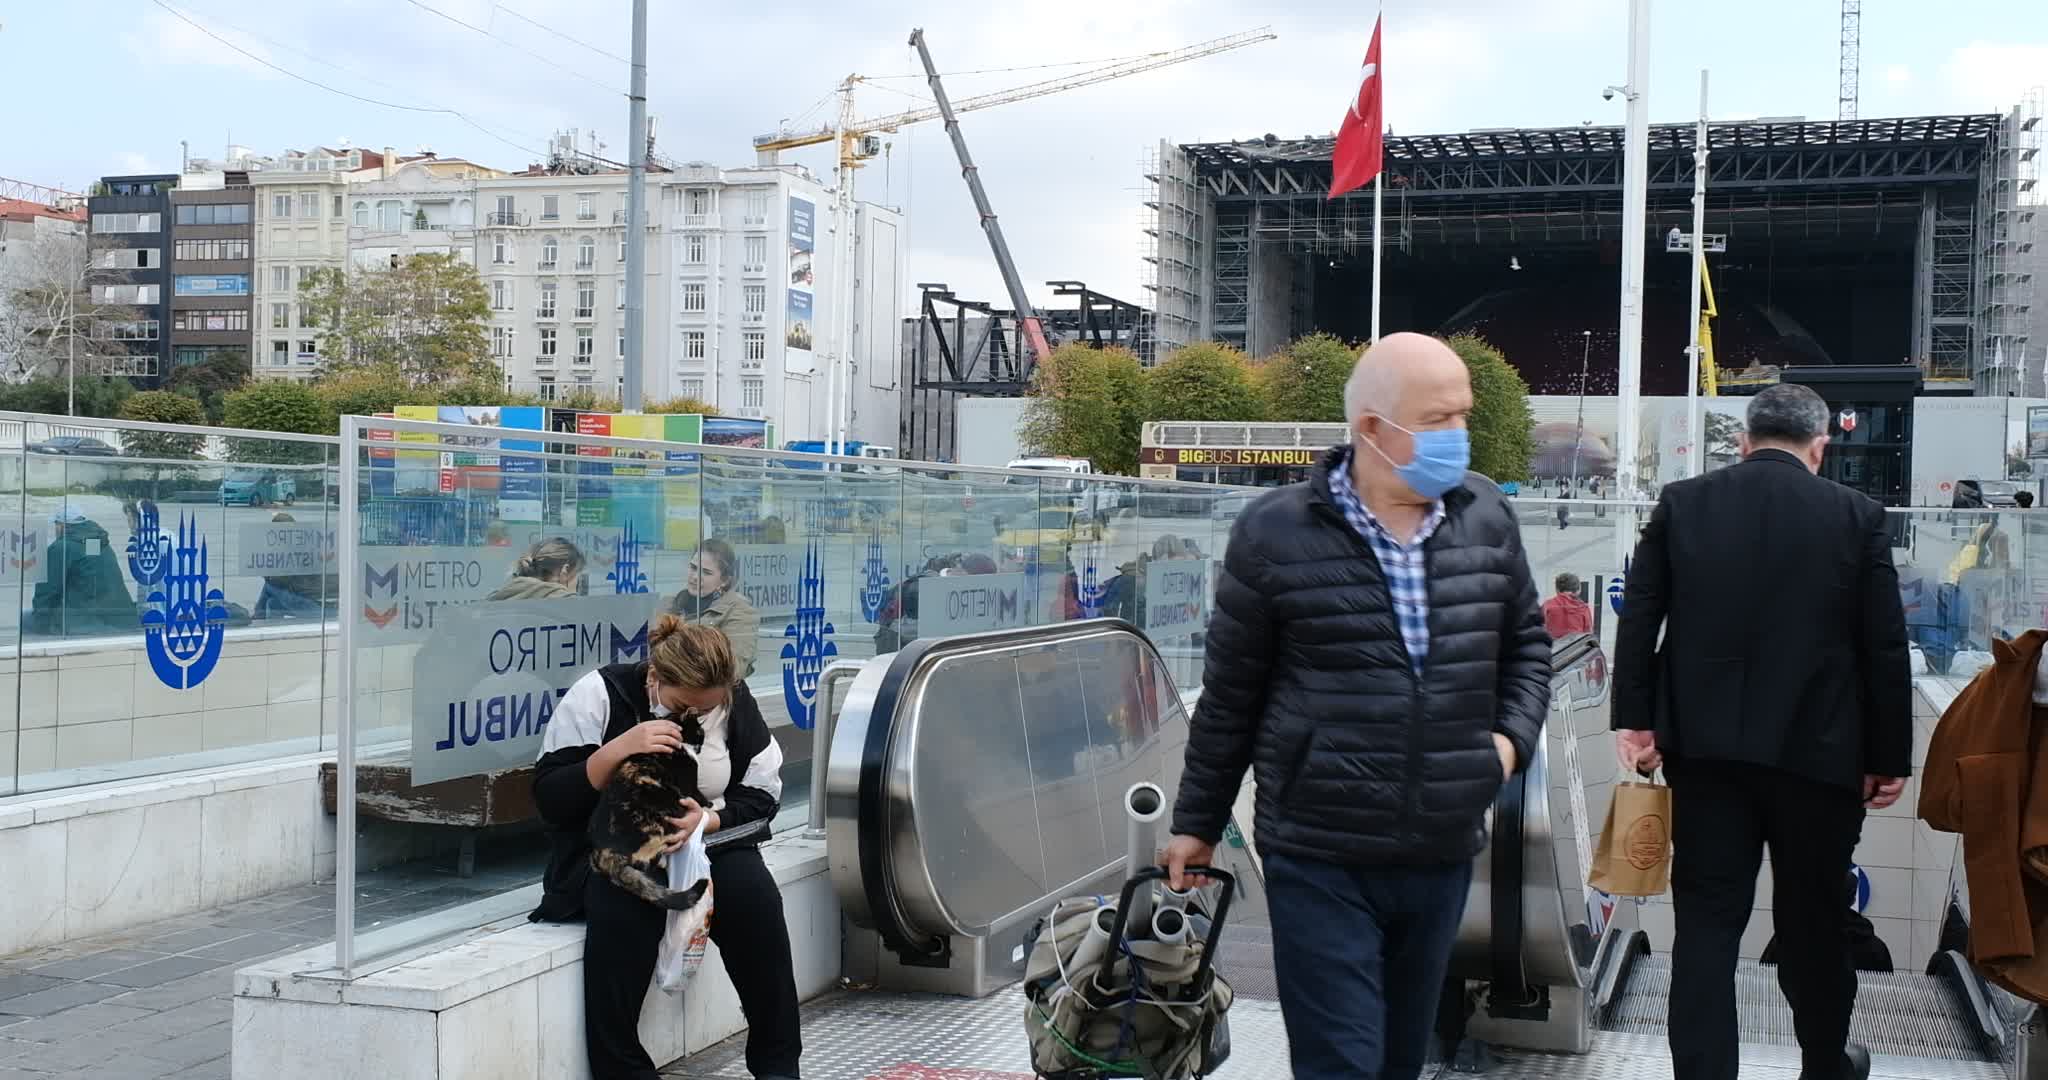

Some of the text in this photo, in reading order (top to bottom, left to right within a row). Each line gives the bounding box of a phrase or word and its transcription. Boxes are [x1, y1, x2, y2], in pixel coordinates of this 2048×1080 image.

[1178, 449, 1315, 464] BIGBUS ISTANBUL
[404, 560, 482, 590] METRO
[743, 553, 789, 577] METRO
[743, 580, 801, 608] İSTANBU
